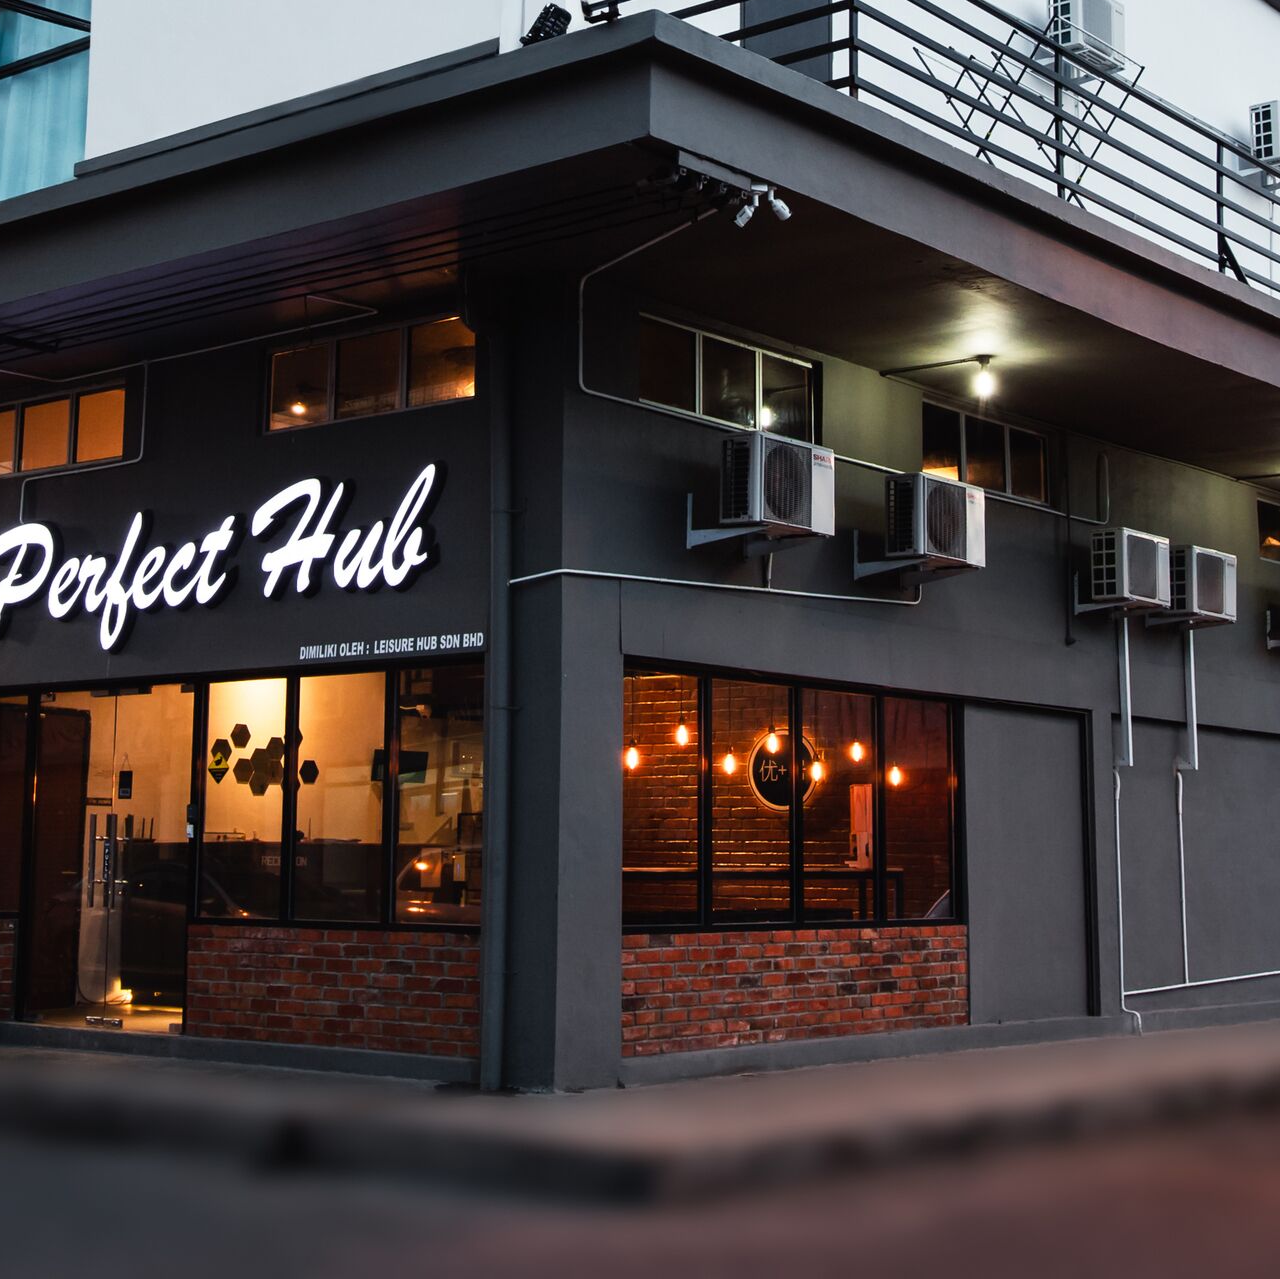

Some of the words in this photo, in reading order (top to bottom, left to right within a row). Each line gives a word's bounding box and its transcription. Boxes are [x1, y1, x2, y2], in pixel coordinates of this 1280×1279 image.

[251, 463, 436, 598] Hub
[299, 643, 337, 660] DIMILIKI
[339, 641, 365, 656] OLEH
[373, 637, 414, 655] LEISURE
[416, 635, 437, 651] HUB
[439, 634, 461, 650] SDN
[463, 632, 484, 648] BHD
[261, 855, 308, 867] RECON
